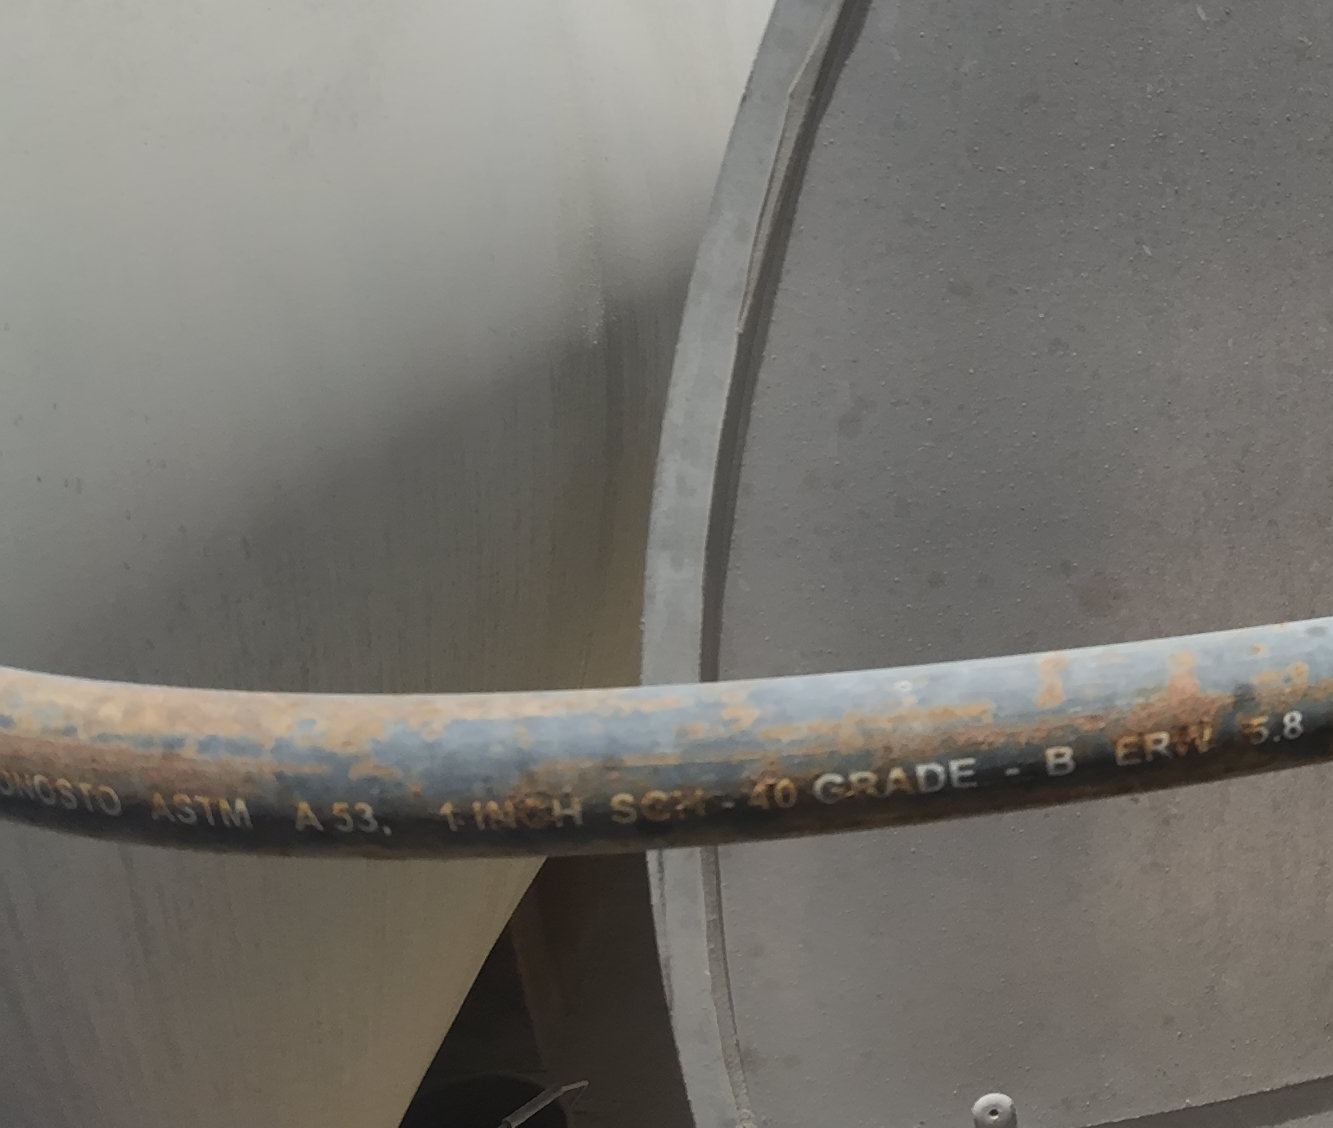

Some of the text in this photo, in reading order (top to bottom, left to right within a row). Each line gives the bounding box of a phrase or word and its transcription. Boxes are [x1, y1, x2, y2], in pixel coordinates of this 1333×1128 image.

[151, 792, 254, 830] ASTM
[813, 756, 978, 805] GRADE
[1044, 745, 1077, 777] B
